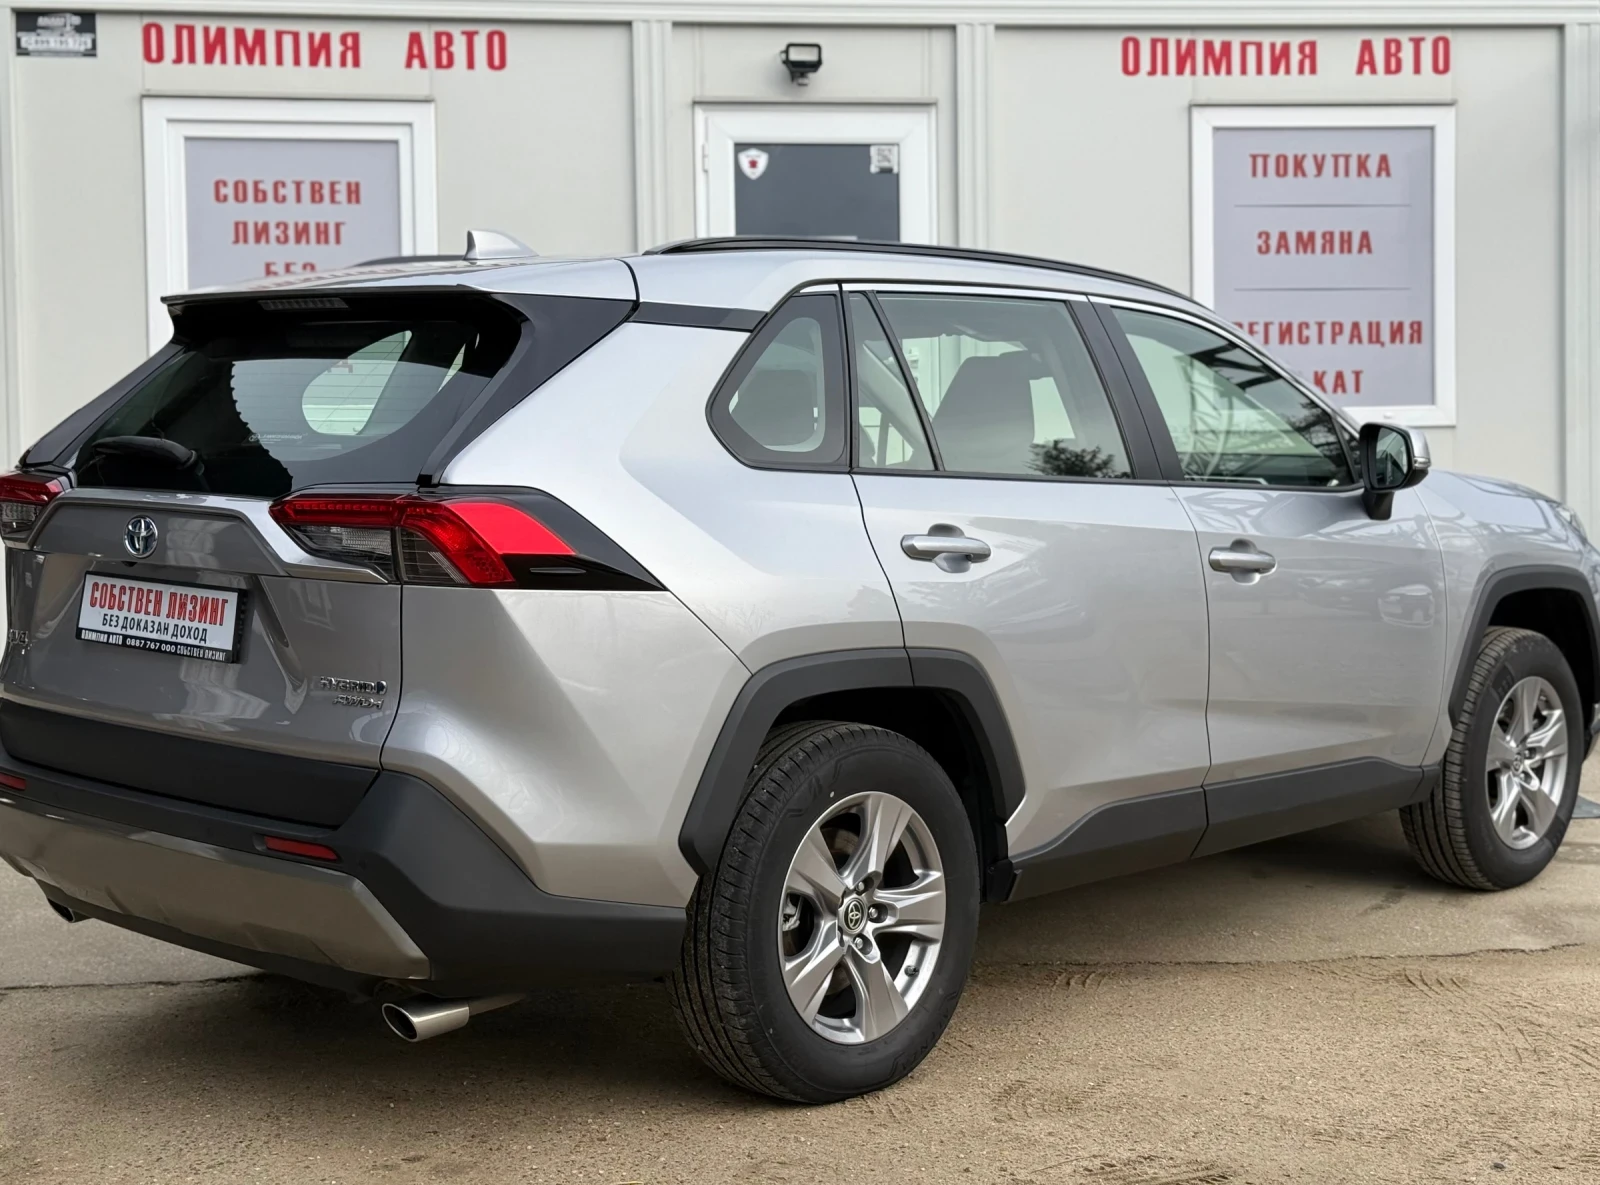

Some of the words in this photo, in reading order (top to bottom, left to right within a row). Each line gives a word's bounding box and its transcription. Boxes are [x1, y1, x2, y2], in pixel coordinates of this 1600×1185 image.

[142, 22, 361, 69] ОЛИМПИЯ
[405, 29, 507, 72] АВТО
[1120, 35, 1318, 77] ОЛИМПИЯ
[1355, 35, 1451, 76] АВТО
[1249, 153, 1392, 179] ПОКУПКА
[213, 179, 361, 205] СОБСТВЕН
[232, 220, 346, 246] ЛИЗИНГ
[1256, 230, 1373, 256] ЗАМЯНА
[1313, 370, 1364, 394] КАТ
[89, 581, 163, 617] СОБСТВЕН
[166, 591, 229, 626] ЛИЗИНГ
[102, 613, 120, 628] БЕЗ
[121, 615, 169, 636] ДОКАЗАН
[171, 626, 208, 645] ДОХОД
[126, 637, 145, 648] 0887
[146, 640, 160, 650] 767
[161, 643, 176, 653] 000
